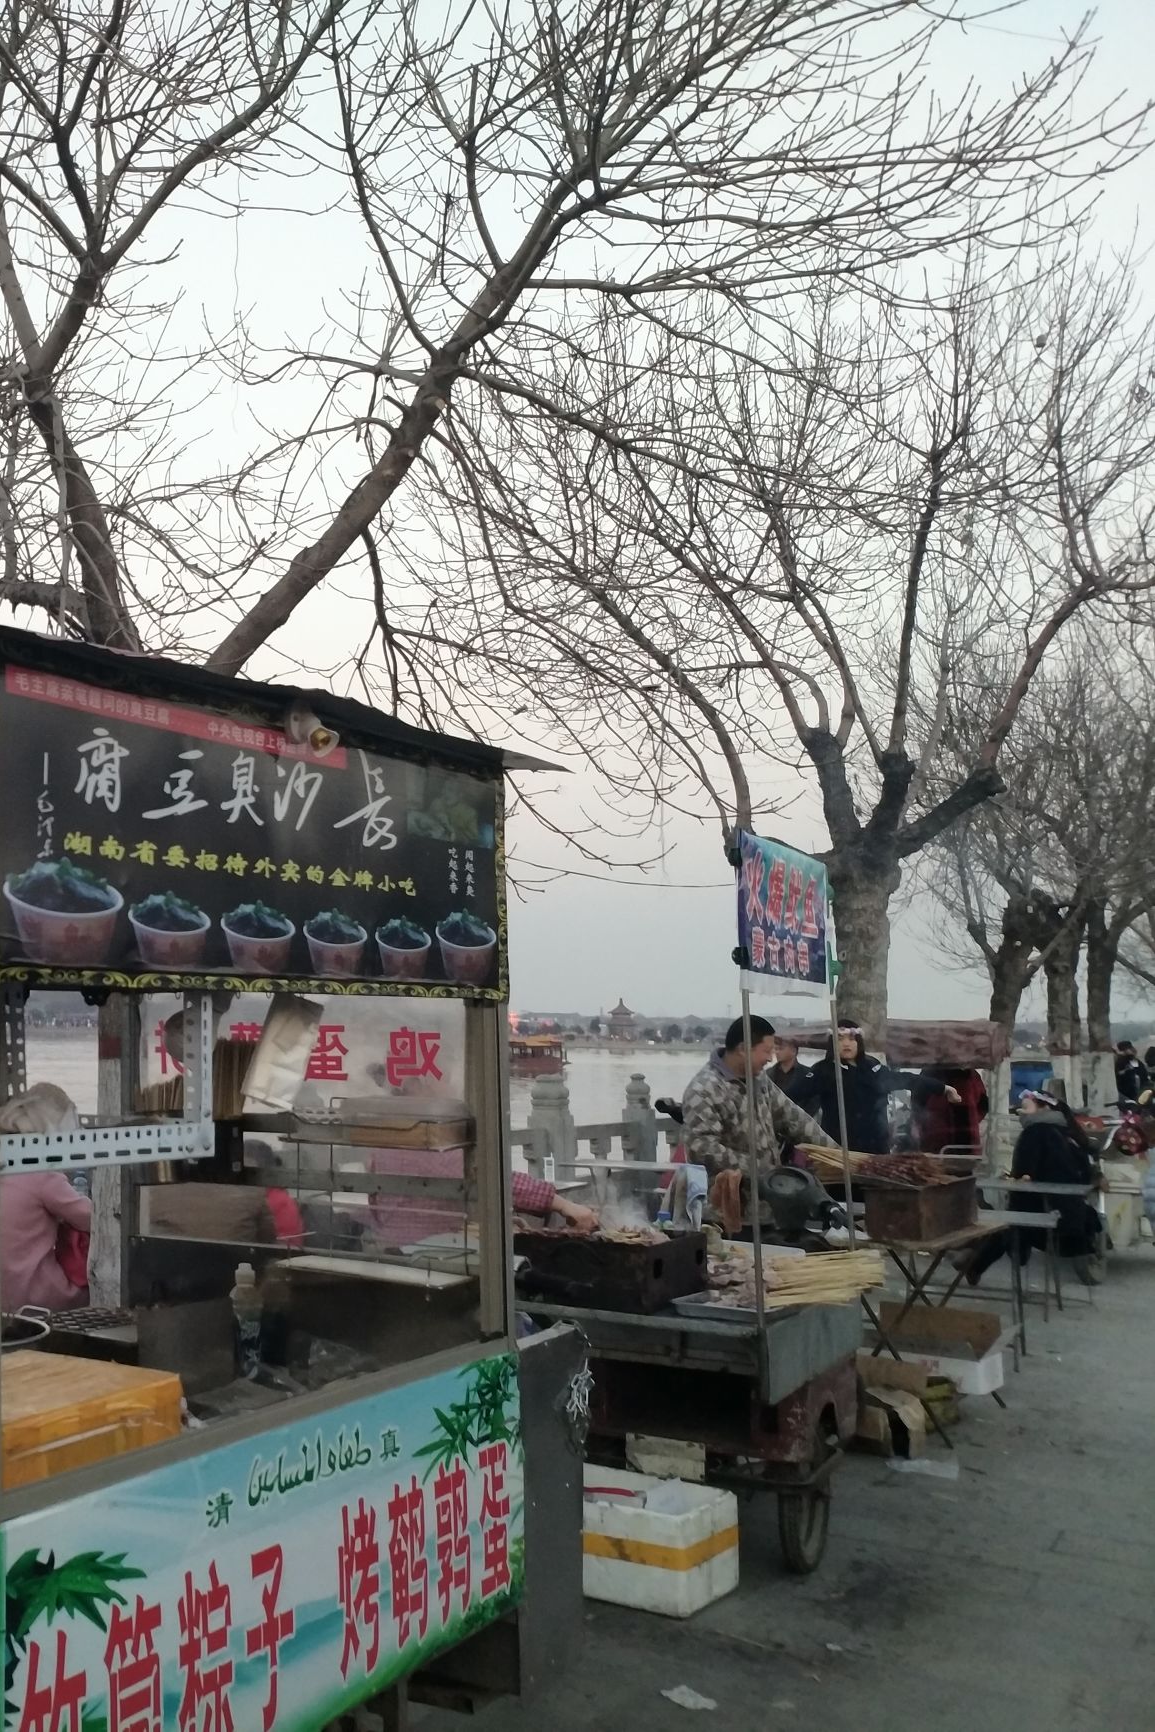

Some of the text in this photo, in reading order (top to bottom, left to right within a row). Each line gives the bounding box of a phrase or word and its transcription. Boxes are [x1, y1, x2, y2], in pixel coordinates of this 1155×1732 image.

[63, 831, 417, 897] 湖南省委招待外宾的金牌小吃
[206, 1491, 233, 1528] 清
[380, 1429, 400, 1462] 真
[337, 1441, 513, 1683] 烤鹌鹑蛋
